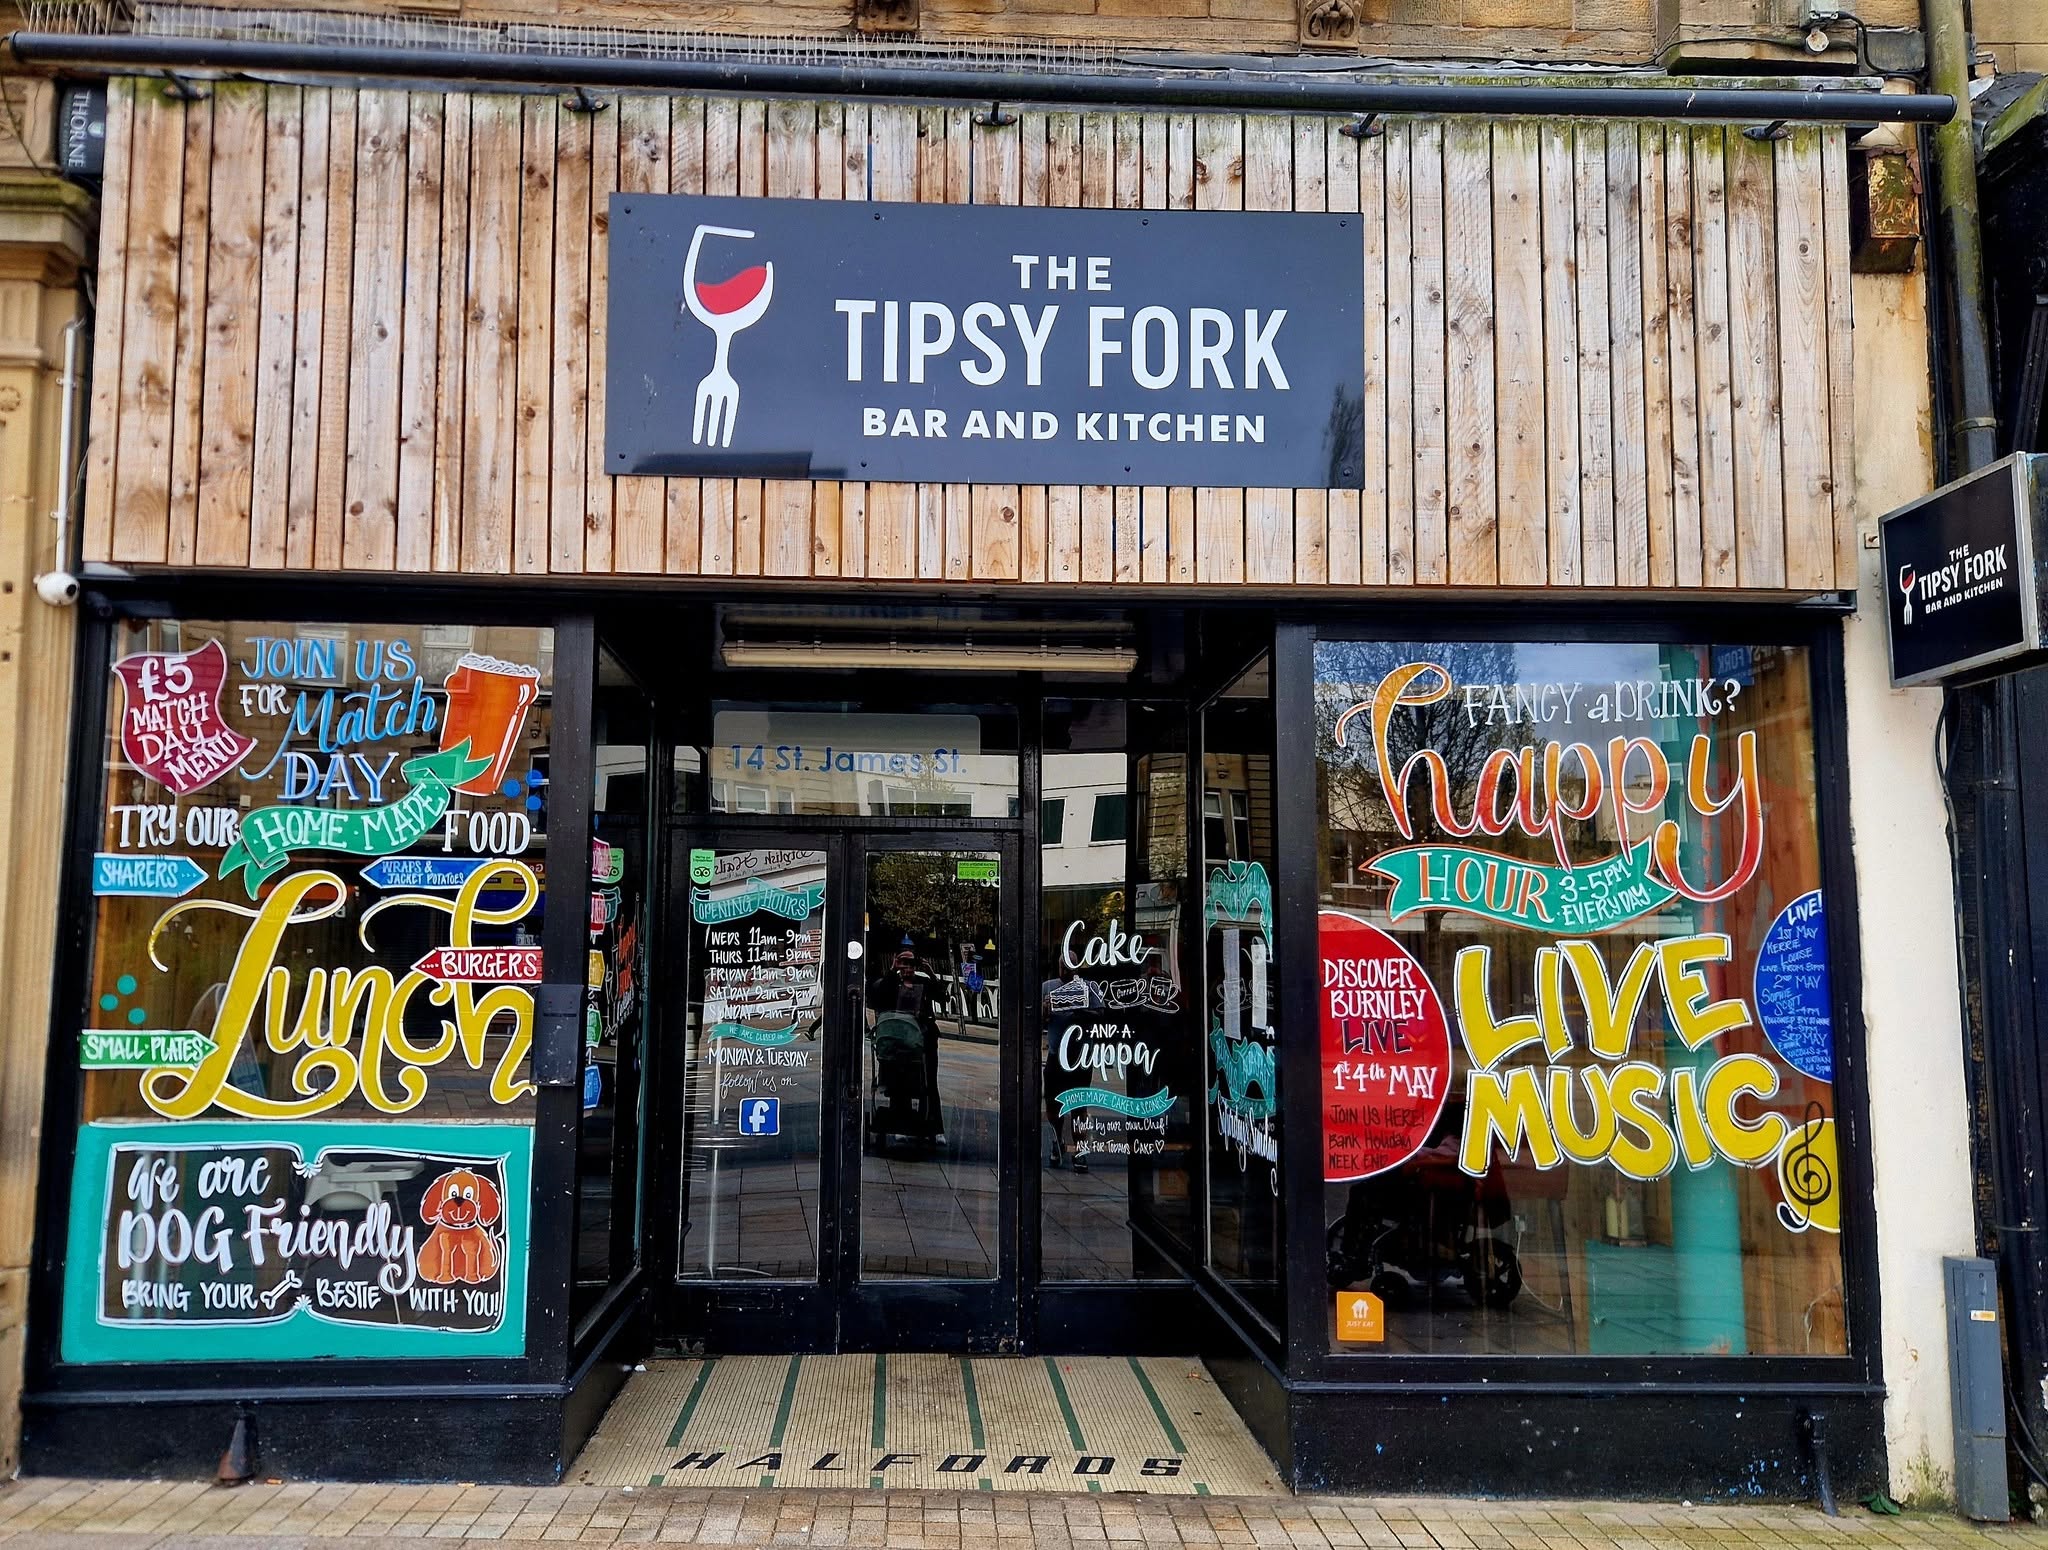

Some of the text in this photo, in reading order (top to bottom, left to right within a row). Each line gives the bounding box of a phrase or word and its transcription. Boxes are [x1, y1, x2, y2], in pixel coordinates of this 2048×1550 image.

[68, 89, 91, 167] THORNE
[1012, 254, 1112, 292] THE
[835, 299, 1290, 391] TIPSY FORK
[863, 407, 1265, 443] BAR AND KITCHEN
[1949, 544, 1969, 561] THE
[1918, 544, 2007, 600] TIPSY FORK
[1925, 577, 2003, 614] BAR AND KITCHEN
[241, 637, 418, 682] JOIN US
[137, 654, 193, 703] £5
[130, 690, 209, 735] MATCH
[1463, 681, 1580, 729] FANCY
[1614, 677, 1741, 721] DRINK?
[137, 723, 220, 765] DAY
[239, 675, 438, 781] FOR Match
[165, 732, 240, 792] MENU
[277, 751, 401, 802] DAY
[732, 743, 968, 775] 14 St. James St.
[1335, 662, 1763, 902] happy
[109, 805, 241, 849] TRY OUR
[255, 787, 449, 853] HOME MADE
[442, 810, 532, 854] FOOD
[98, 860, 178, 889] SHARERS
[382, 861, 433, 873] WRAPS &
[387, 873, 464, 885] JACKET POTATOES
[1558, 861, 1629, 901] 3-5PM
[698, 889, 807, 920] OPENING HOURS
[1417, 851, 1555, 924] HOUR
[1787, 892, 1823, 926] LIVE!
[711, 931, 740, 946] WEDS
[1062, 919, 1153, 968] Cake
[440, 950, 538, 978] BURGERS
[709, 950, 743, 964] THURS
[1323, 958, 1416, 989] DISCOVER
[139, 858, 539, 1120] Lunch
[709, 968, 748, 982] FRIDAY
[1153, 986, 1166, 997] TEA
[1795, 975, 1821, 991] MAY
[1116, 987, 1137, 999] COFFEE
[1330, 989, 1427, 1020] BURNLEY
[1455, 933, 1753, 1071] LIVE
[709, 1005, 752, 1021] SUNDAY
[1090, 1023, 1131, 1038] AND A
[85, 1033, 206, 1063] SMALL PLATES
[1059, 1024, 1160, 1081] Cuppa
[1342, 1019, 1413, 1055] LIVE
[708, 1047, 809, 1067] MONDAY & TUESDAY
[720, 1070, 762, 1099] follow
[762, 1076, 777, 1092] us
[1388, 1066, 1438, 1100] MAY
[1111, 1096, 1135, 1114] CAKES
[1141, 1096, 1167, 1115] SCONES
[1330, 1105, 1425, 1128] JOIN US HERE!
[1458, 1053, 1789, 1182] MUSIC
[1073, 1116, 1094, 1134] Made
[1095, 1118, 1105, 1135] by
[1329, 1133, 1360, 1150] Bank
[1092, 1141, 1104, 1152] FOR
[1133, 1138, 1155, 1155] CAKE
[1329, 1153, 1359, 1170] WEEK
[127, 1155, 272, 1208] We are
[117, 1197, 418, 1296] DOG Friendly
[121, 1280, 499, 1317] BRING YOUR BESTIE WITH YOU!
[671, 1451, 1184, 1478] HALFORDS
